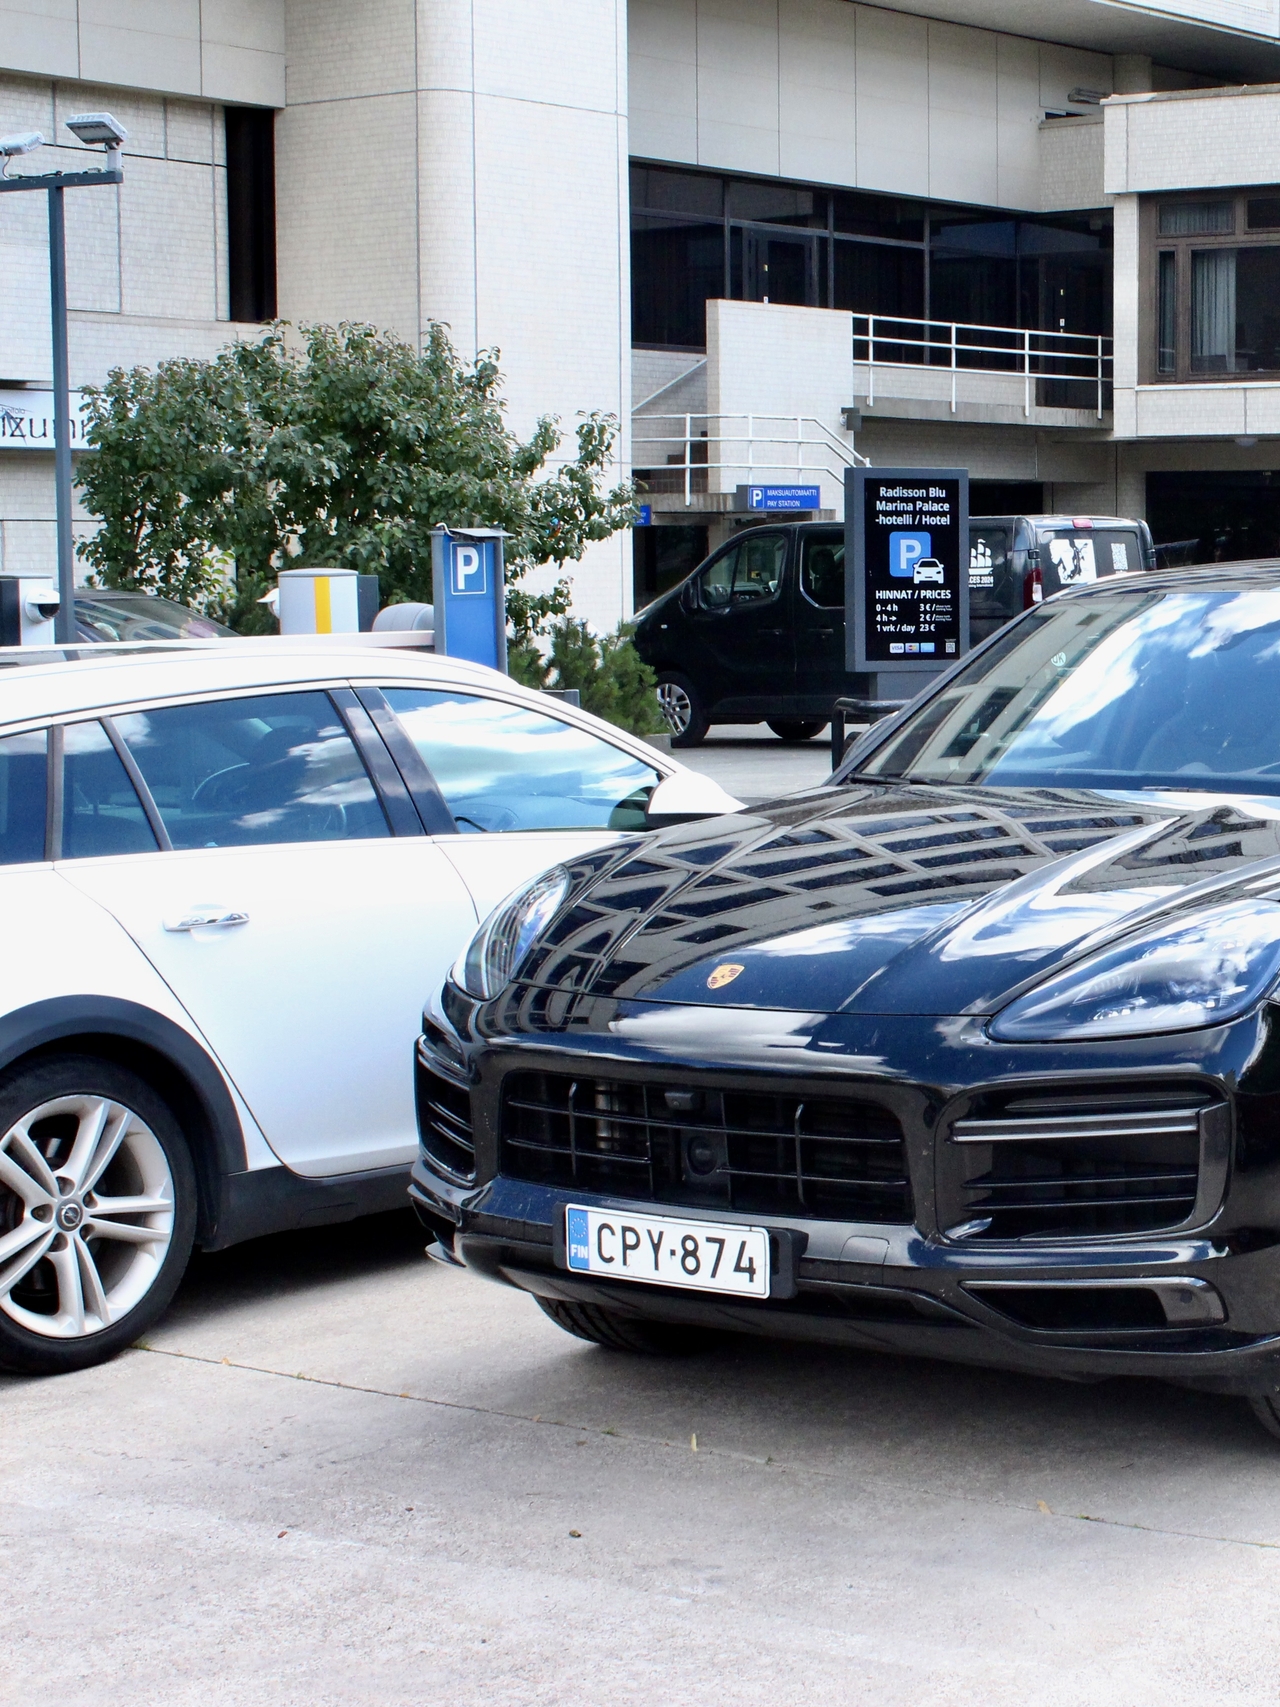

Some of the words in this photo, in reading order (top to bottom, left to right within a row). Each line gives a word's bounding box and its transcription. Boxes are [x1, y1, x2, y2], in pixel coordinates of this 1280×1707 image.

[767, 489, 817, 497] MAKSUAUTOMAATTI
[879, 486, 926, 498] Radisson
[929, 487, 946, 498] Blu
[876, 500, 913, 511] Marina
[916, 501, 950, 511] Palace
[875, 514, 913, 525] -hotelli
[922, 514, 950, 525] Hotel
[457, 546, 479, 590] P
[875, 590, 913, 600] HINNAT
[920, 590, 952, 599] PRICES
[882, 624, 895, 632] vrk
[901, 624, 916, 634] day
[919, 624, 929, 632] 23
[570, 1244, 588, 1260] FIN
